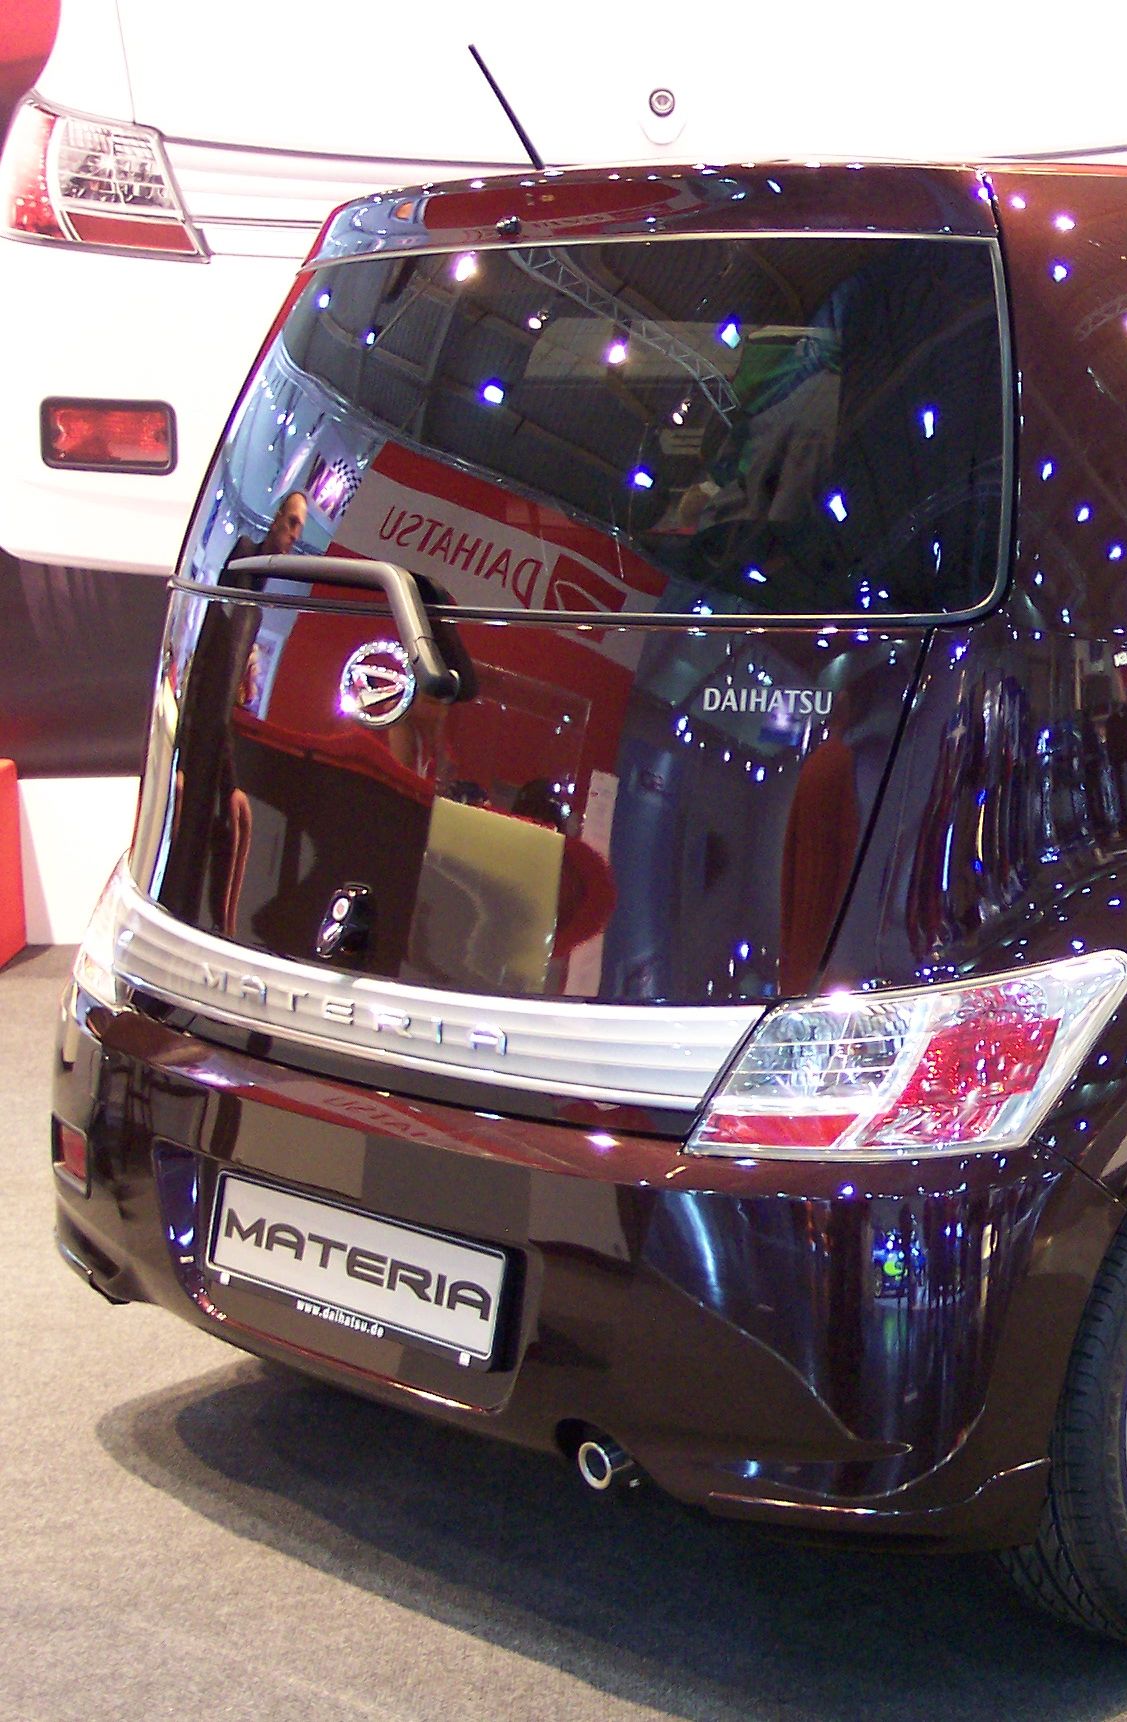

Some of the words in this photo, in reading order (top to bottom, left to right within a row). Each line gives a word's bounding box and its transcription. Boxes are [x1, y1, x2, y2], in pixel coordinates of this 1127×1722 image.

[702, 687, 833, 715] DAIHATSU
[200, 961, 508, 1056] MATERIA
[223, 1207, 493, 1322] MATERIA
[296, 1299, 385, 1338] www.daihatsu.de
